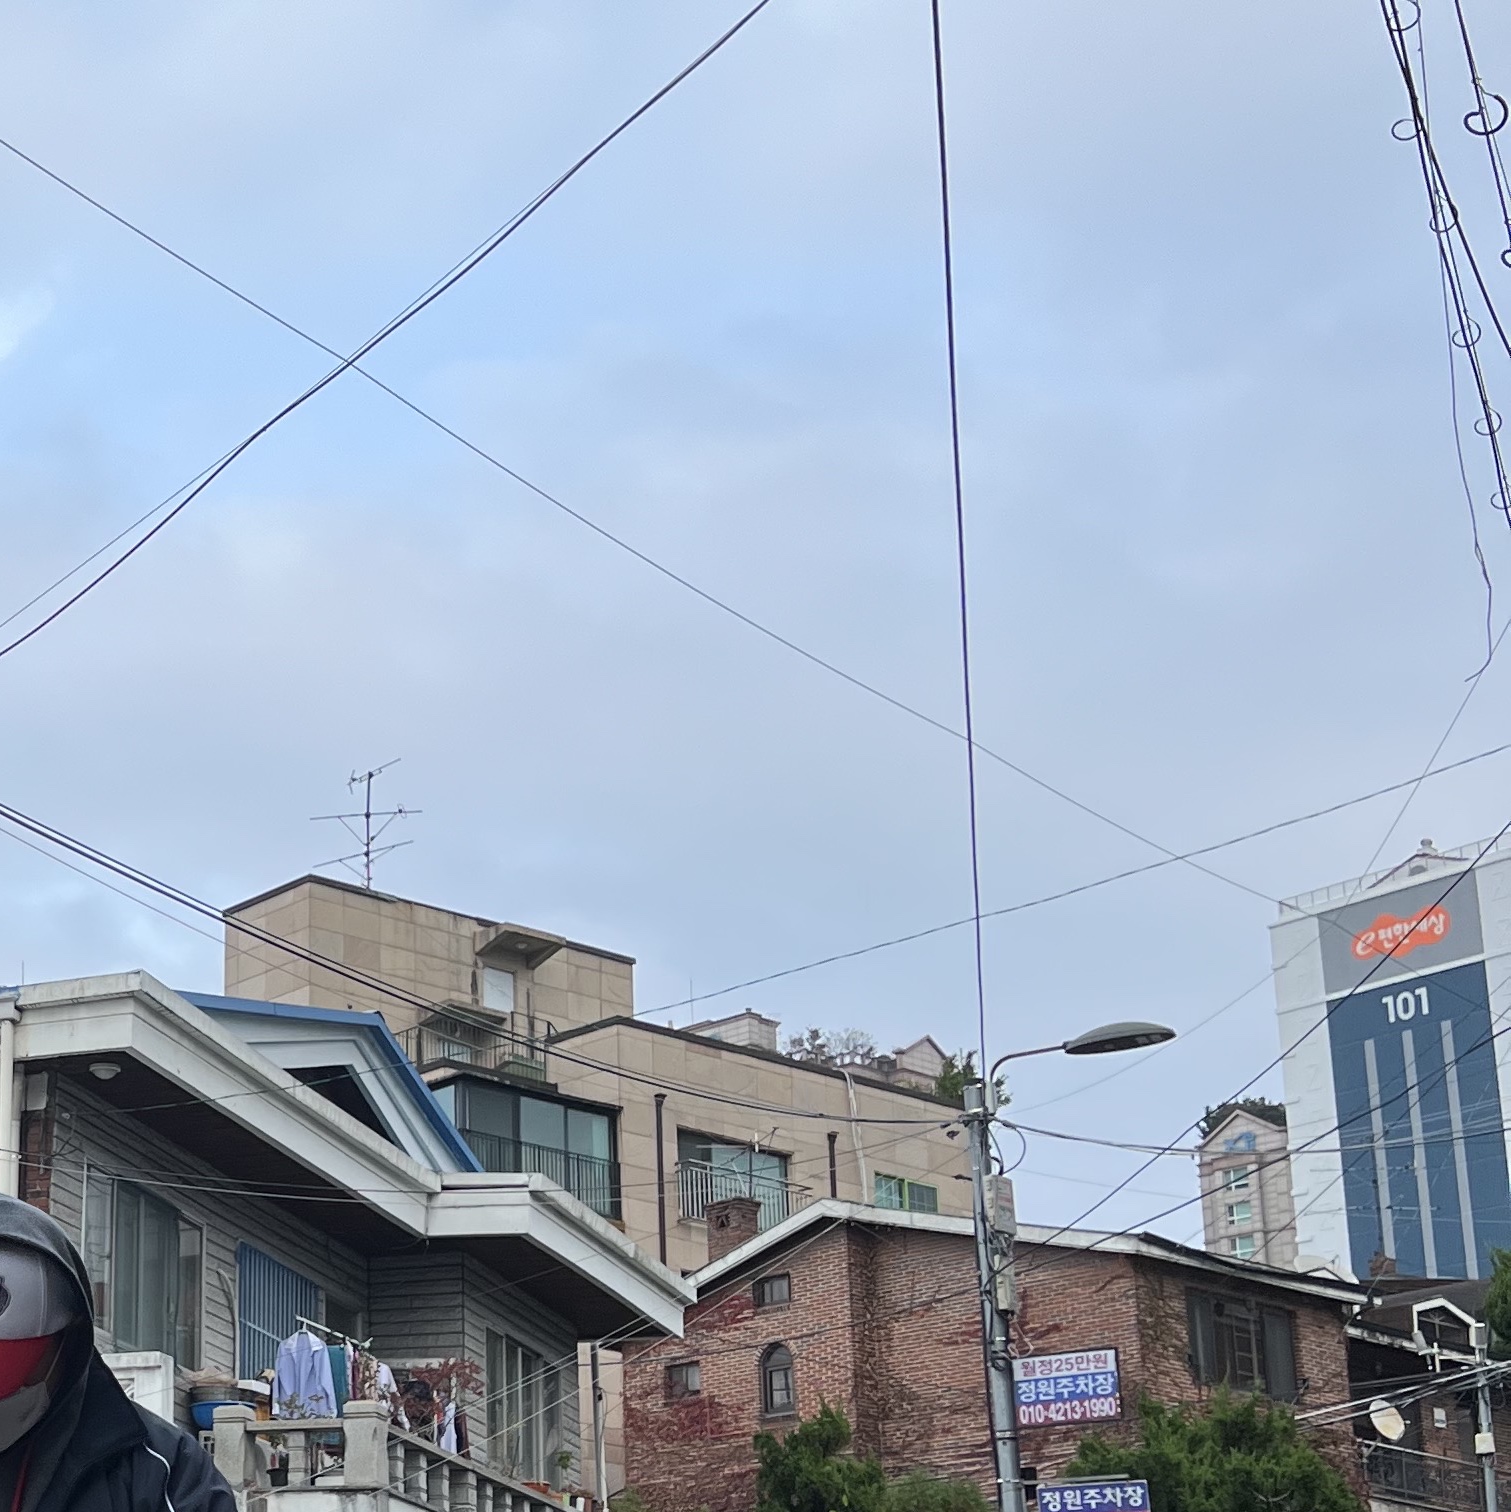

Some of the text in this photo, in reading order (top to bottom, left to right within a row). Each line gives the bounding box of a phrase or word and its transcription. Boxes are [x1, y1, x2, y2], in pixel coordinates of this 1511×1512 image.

[1381, 986, 1430, 1024] 101
[1021, 1352, 1109, 1378] 월정25만원
[1017, 1372, 1115, 1403] 정원주차장
[1019, 1398, 1116, 1425] 010-4213-1990
[1041, 1485, 1145, 1512] 정원주차장
